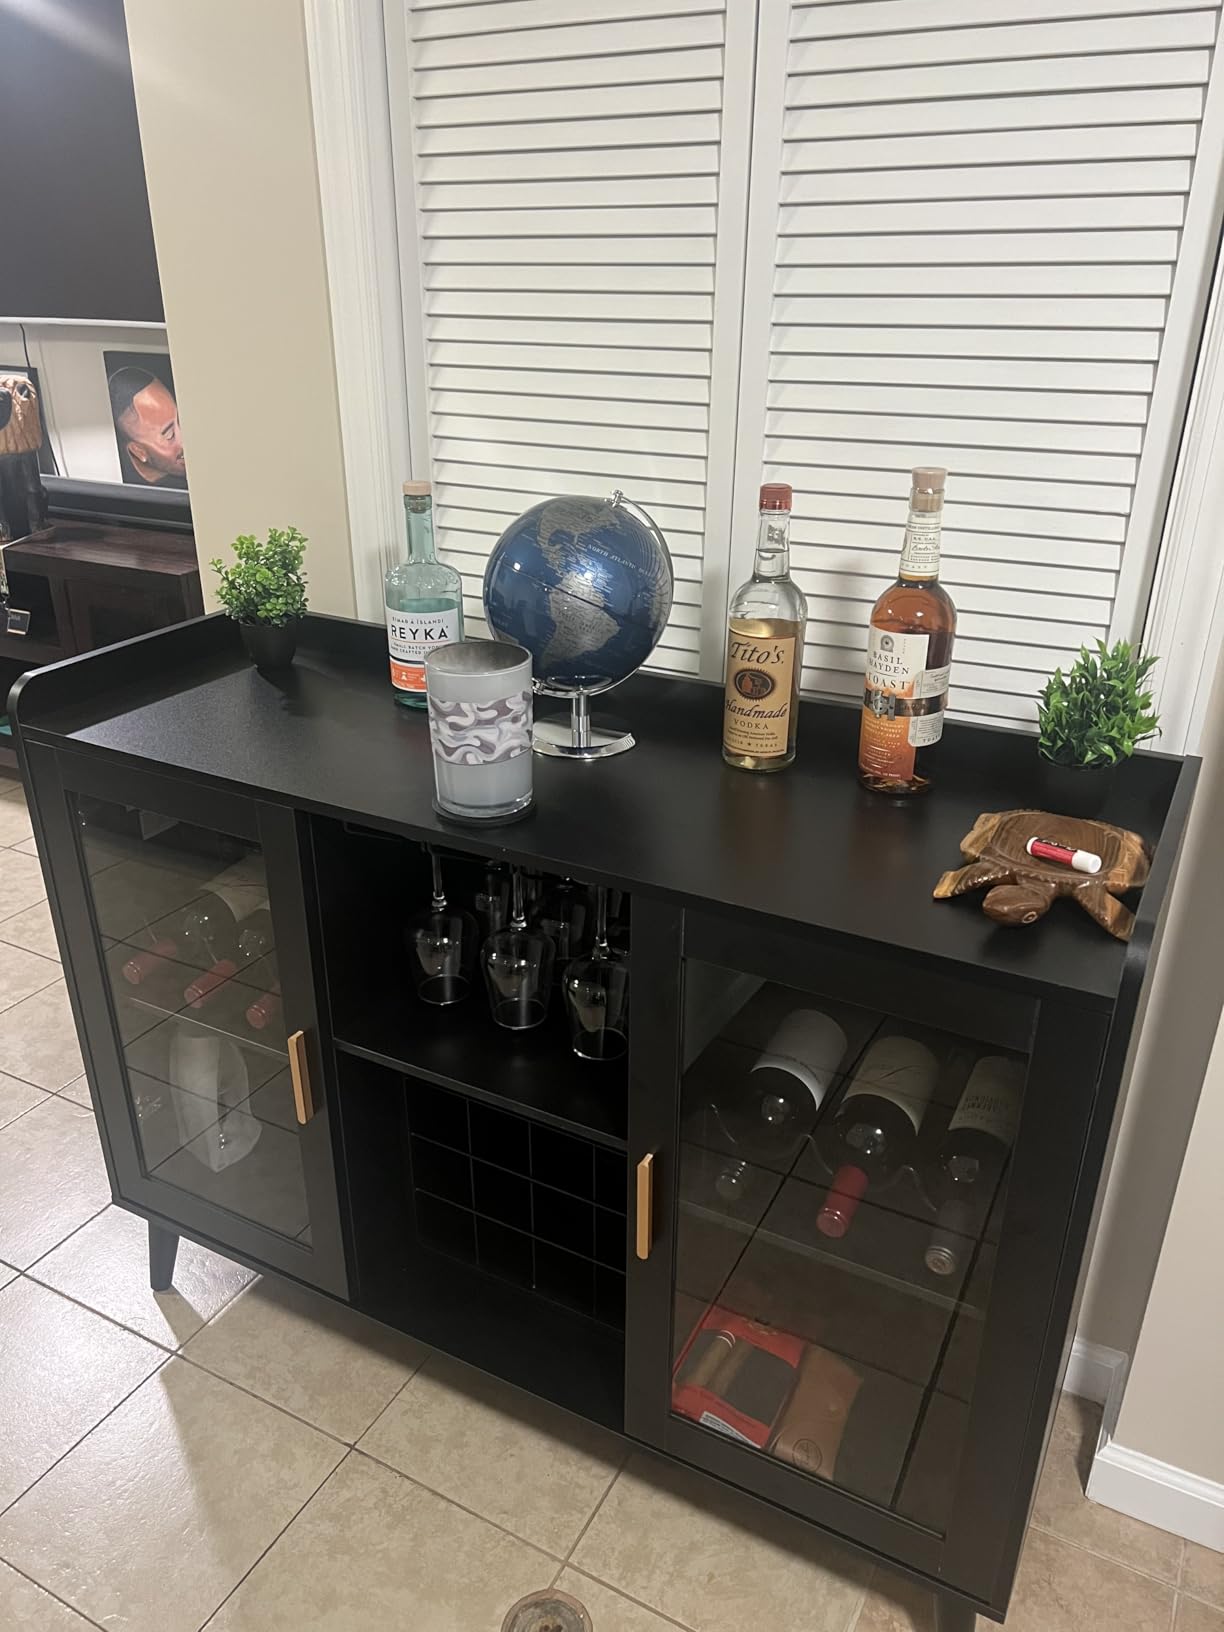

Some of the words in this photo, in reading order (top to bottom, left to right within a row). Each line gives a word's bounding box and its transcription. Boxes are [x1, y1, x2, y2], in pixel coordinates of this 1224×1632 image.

[391, 624, 448, 640] REYKA
[873, 651, 902, 665] BASIL
[866, 672, 910, 690] TOAST
[726, 700, 788, 719] Handmade
[734, 719, 769, 730] VODKA
